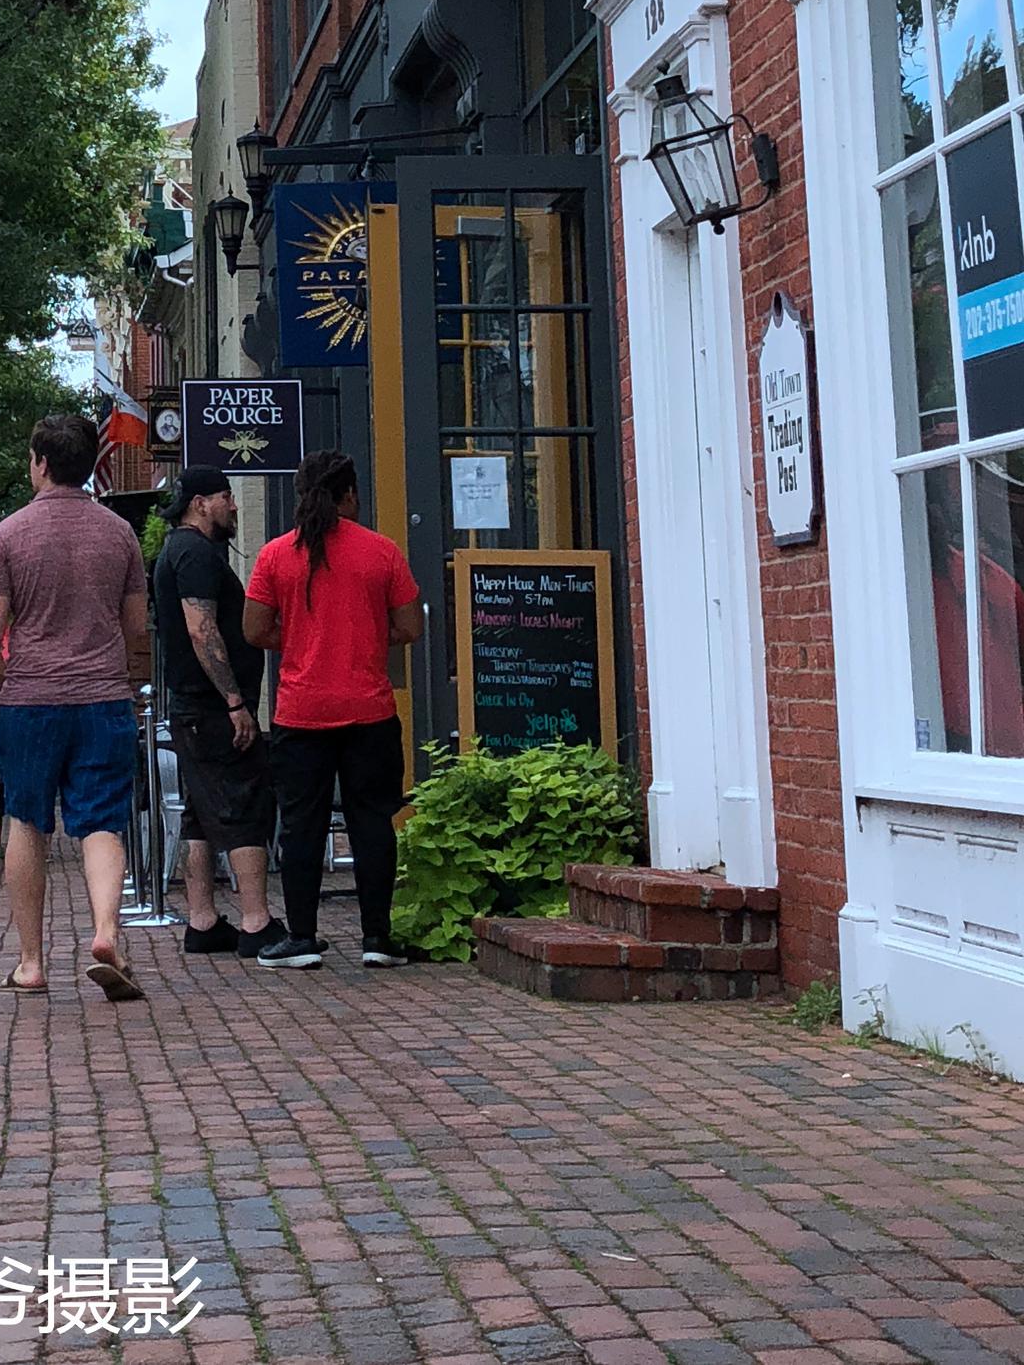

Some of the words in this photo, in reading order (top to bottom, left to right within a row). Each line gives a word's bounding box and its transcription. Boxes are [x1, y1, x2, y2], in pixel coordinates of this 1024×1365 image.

[957, 215, 996, 271] klnb
[208, 388, 276, 406] PAPER
[764, 370, 778, 404] Old
[778, 369, 802, 399] Town
[202, 407, 284, 425] SOURCE
[767, 409, 803, 453] Trading
[777, 456, 798, 495] Post
